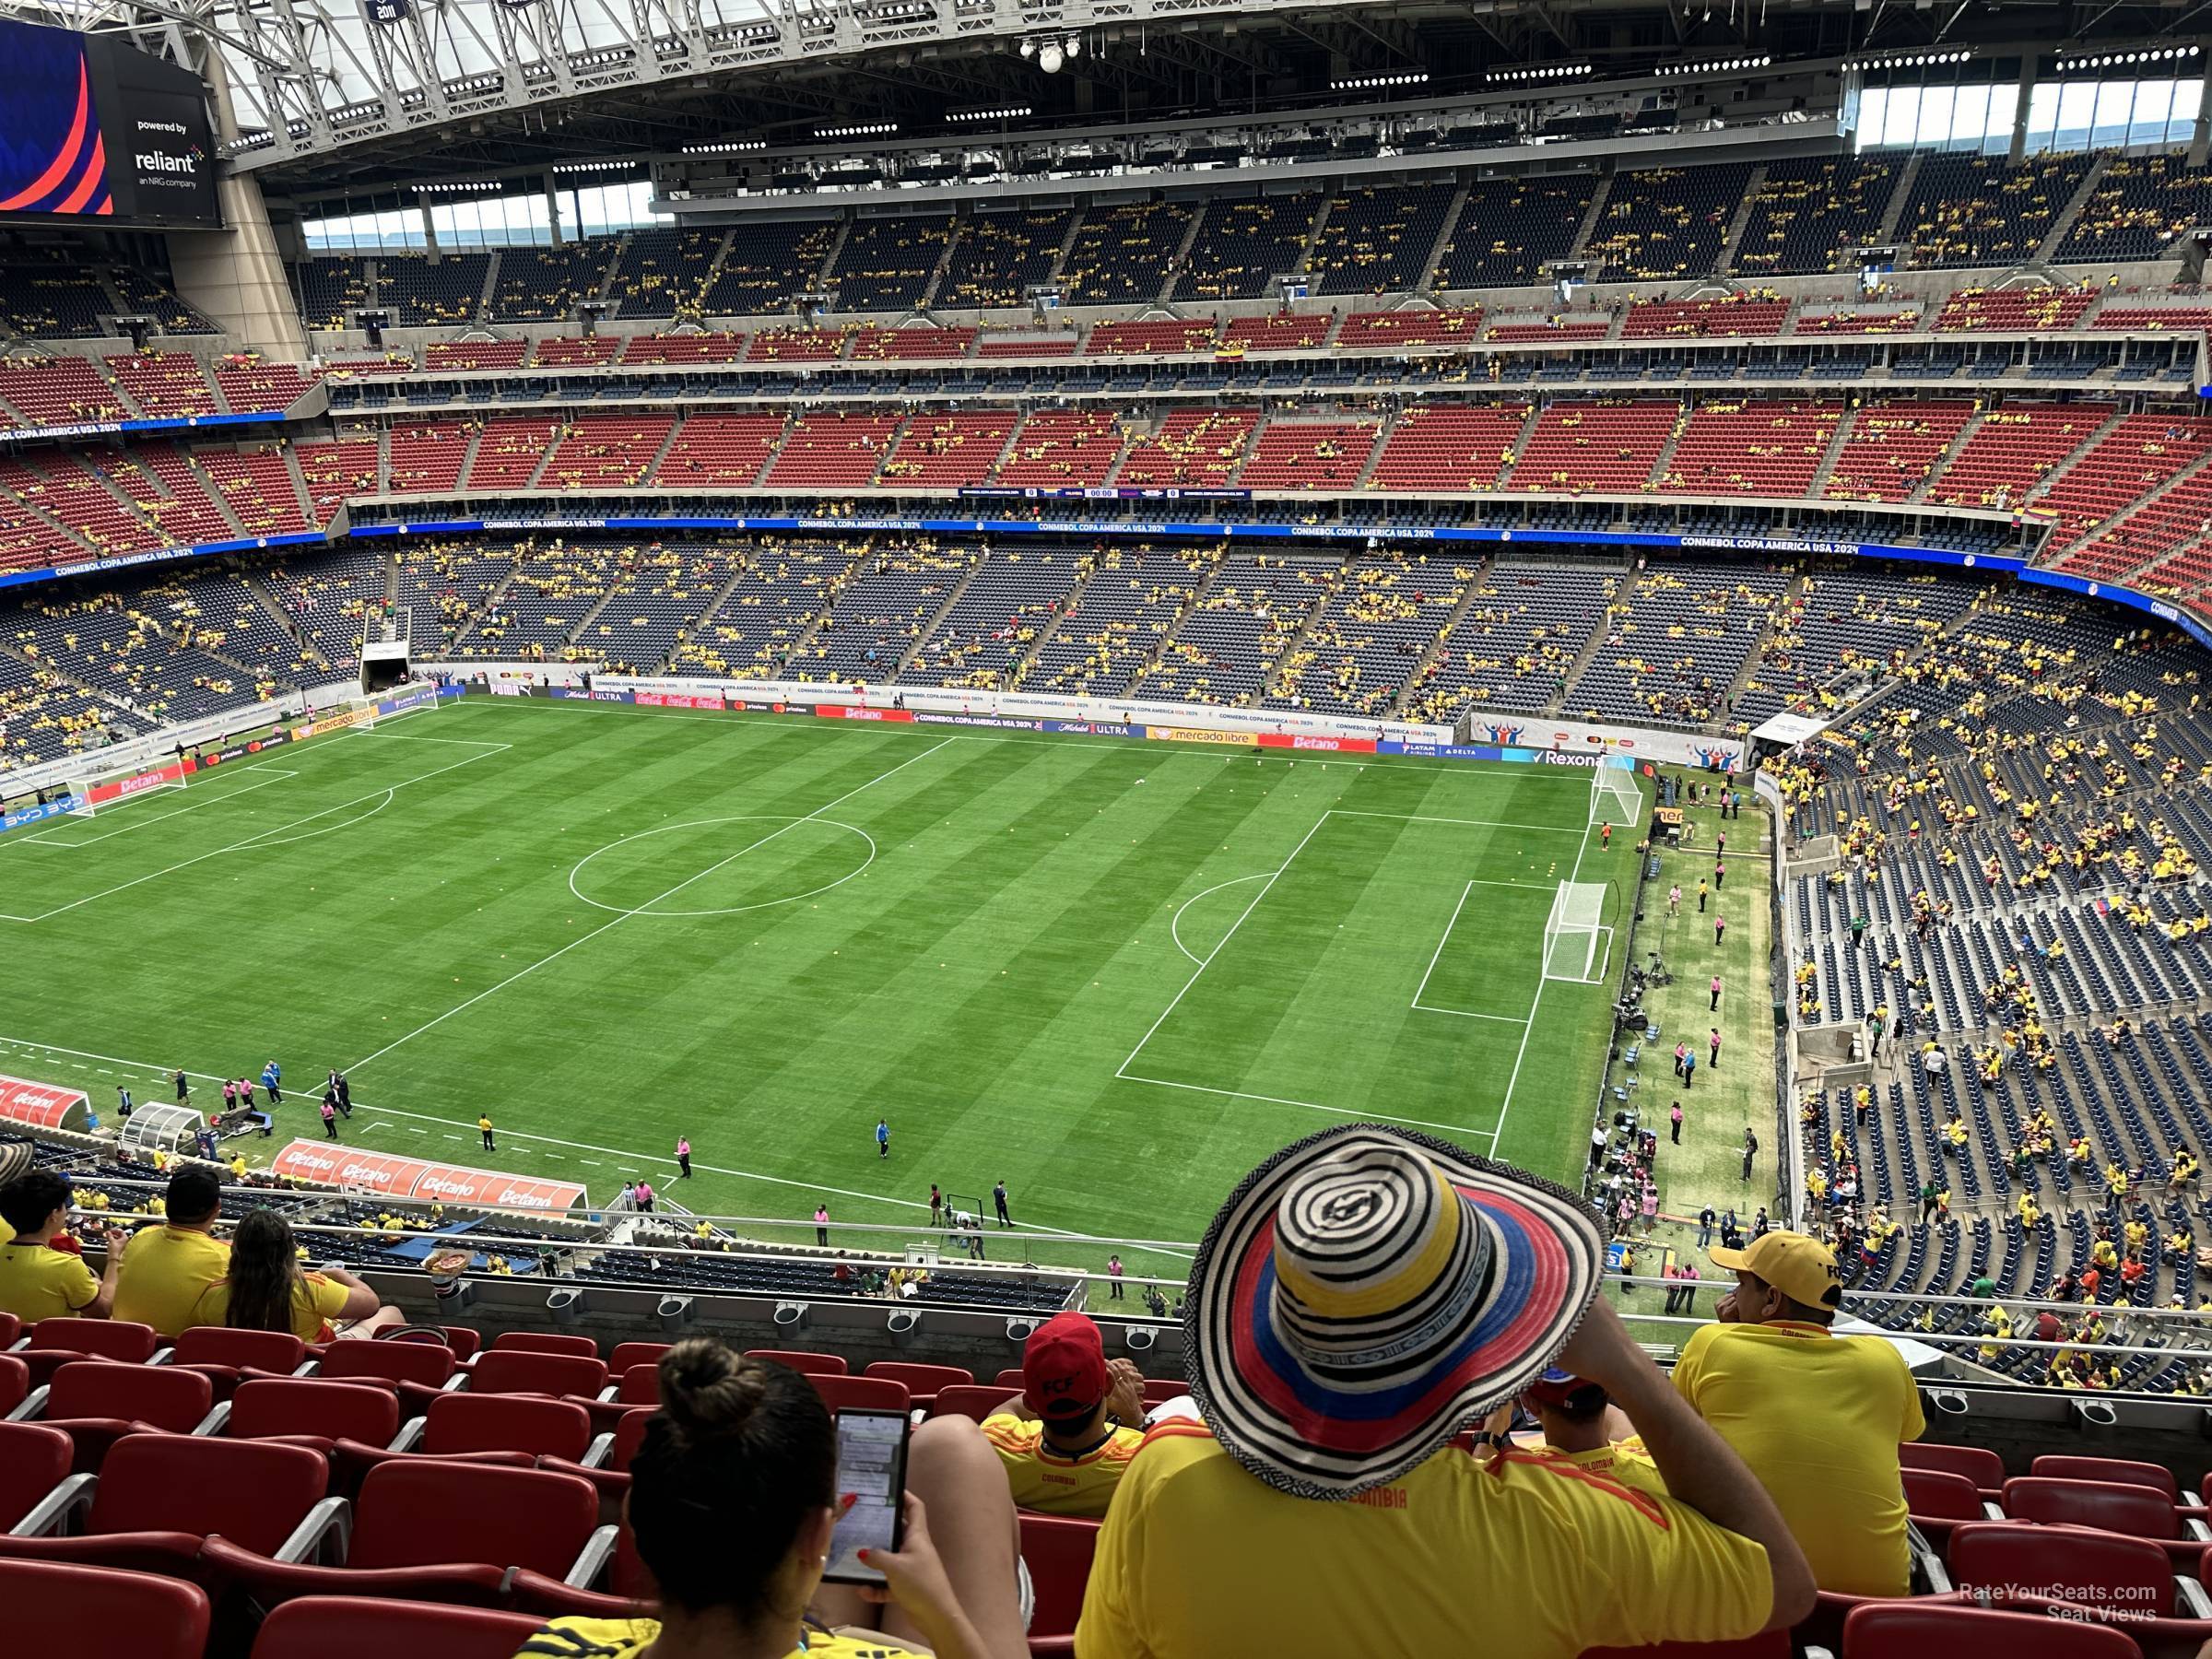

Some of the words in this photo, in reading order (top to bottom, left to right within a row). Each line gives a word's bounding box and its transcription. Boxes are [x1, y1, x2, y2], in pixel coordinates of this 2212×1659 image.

[378, 5, 396, 18] 2011
[138, 121, 175, 132] powered
[176, 123, 186, 135] by
[135, 150, 195, 172] reliant
[148, 177, 165, 185] NRG
[166, 179, 196, 190] company
[15, 429, 39, 440] COPA
[39, 427, 79, 437] AMERICA
[81, 425, 99, 434] USA
[99, 423, 121, 432] 2024
[1079, 524, 1098, 532] COPA
[1099, 524, 1132, 532] AMERICA
[1291, 527, 1335, 535] CONMEBOL
[1336, 528, 1359, 536] COPA
[1359, 528, 1395, 537] AMERICA
[1397, 529, 1413, 537] USA
[1680, 537, 1735, 547] CONMEBOL
[1737, 539, 1764, 549] COPA
[1765, 541, 1811, 552] AMERICA
[1812, 544, 1832, 553] USA
[1833, 545, 1859, 554] 2024
[55, 564, 100, 576] CONMEBOL
[101, 559, 122, 569] COPA
[122, 554, 156, 565] AMERICA
[157, 551, 172, 560] USA
[174, 548, 194, 558] 2024
[490, 684, 519, 696] PUMA
[595, 692, 621, 701] ULTRA
[845, 708, 882, 720] Betano
[920, 714, 954, 724] CONMEBOL
[955, 716, 969, 724] COPA
[969, 717, 1001, 726] AMERICA
[316, 714, 353, 732] mercado
[1097, 725, 1128, 735] ULTRA
[1176, 730, 1223, 742] mercado
[1225, 731, 1249, 743] libre
[1293, 735, 1339, 749] Betano
[1546, 750, 1602, 767] Rexona
[120, 772, 163, 794] Betano
[13, 1092, 54, 1107] Betano
[286, 1151, 335, 1170] Betano
[341, 1164, 391, 1182] Betano
[422, 1177, 476, 1196] Betano
[1042, 1377, 1074, 1396] FCF
